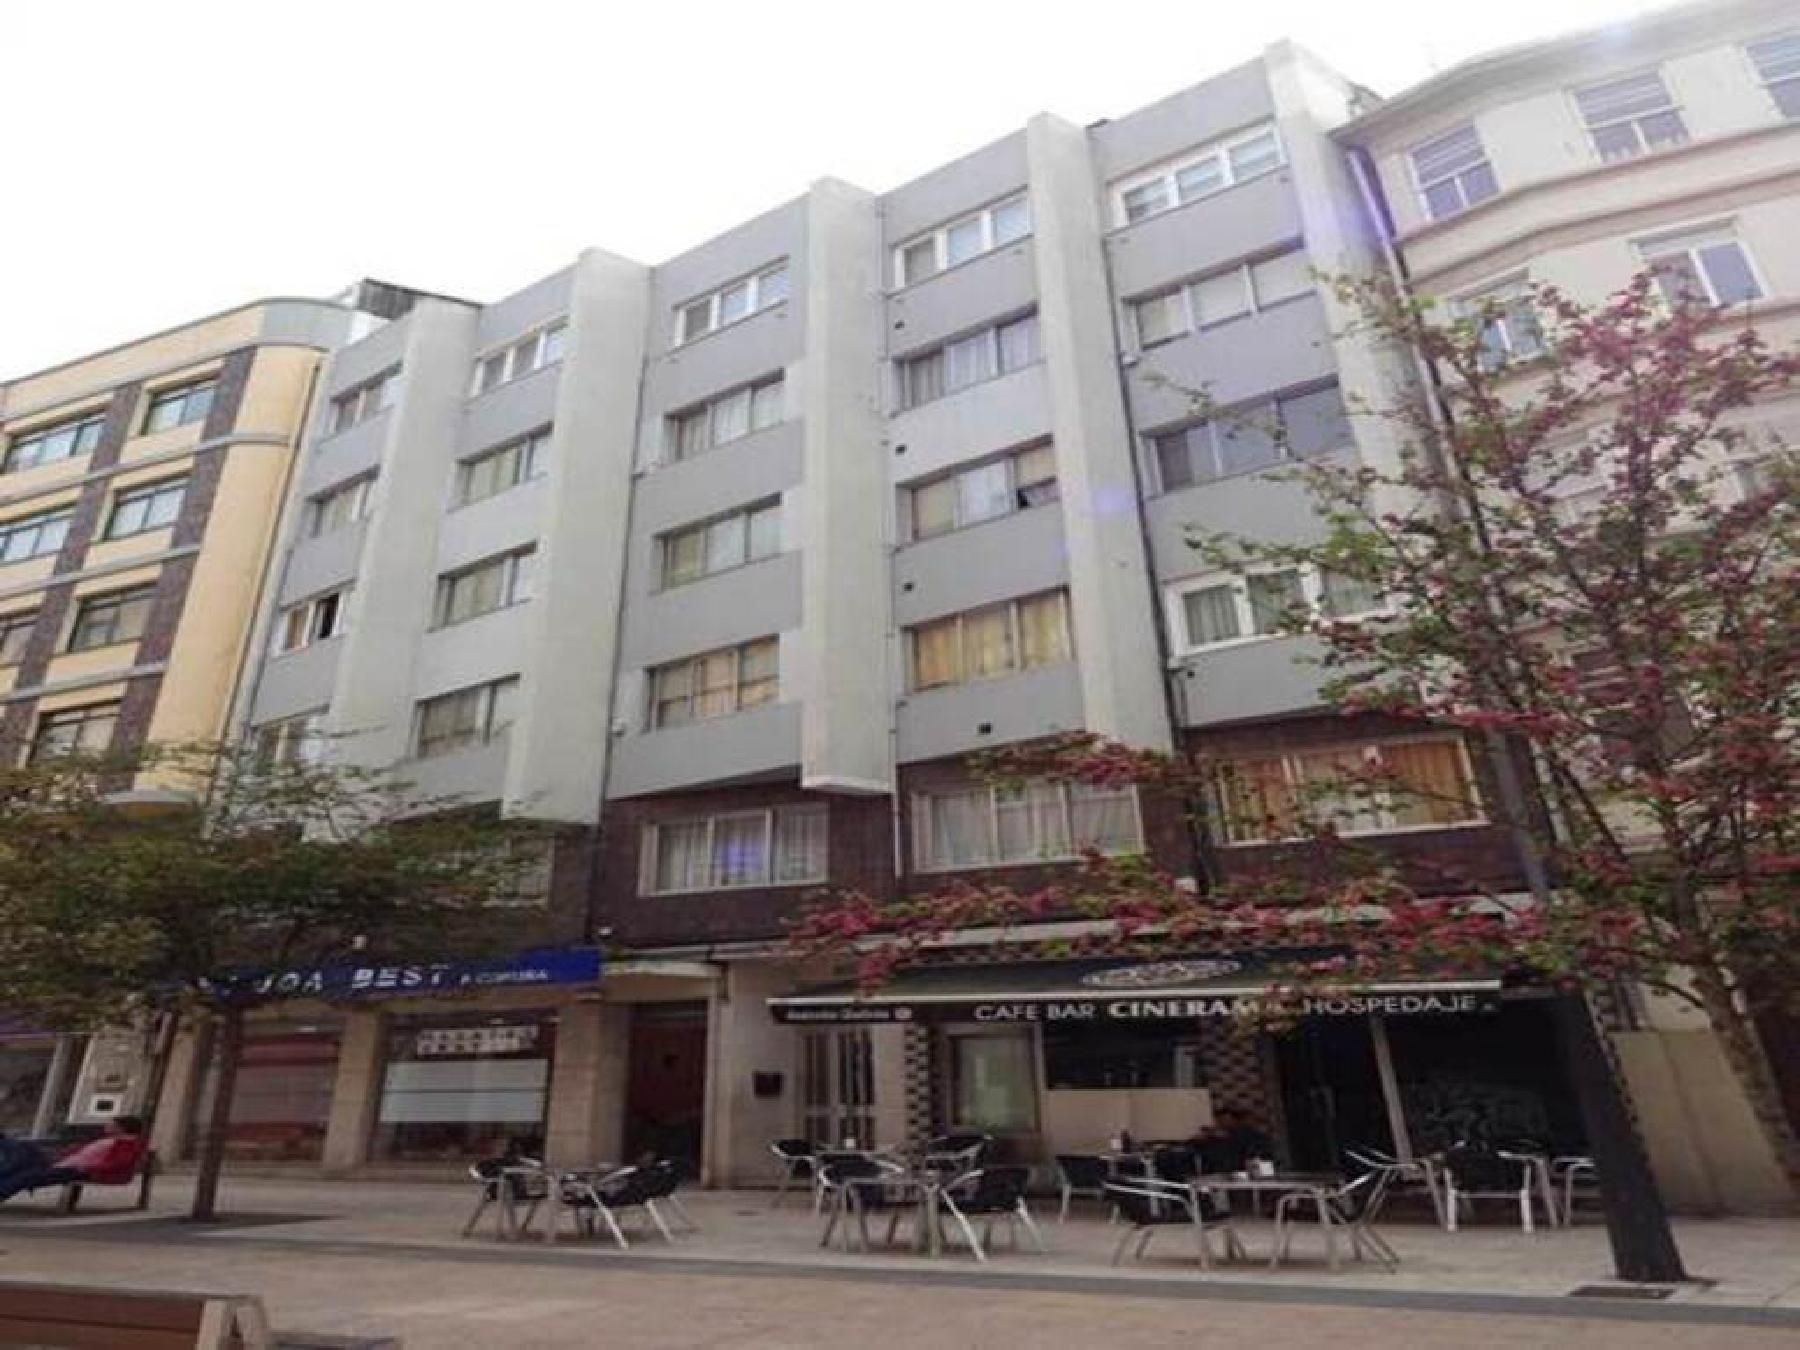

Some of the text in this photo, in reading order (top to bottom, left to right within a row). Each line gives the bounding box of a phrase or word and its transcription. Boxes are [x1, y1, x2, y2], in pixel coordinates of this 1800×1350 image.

[351, 963, 449, 988] BEST
[1047, 1003, 1097, 1020] BAR
[1303, 994, 1478, 1015] HOSPEDAJE
